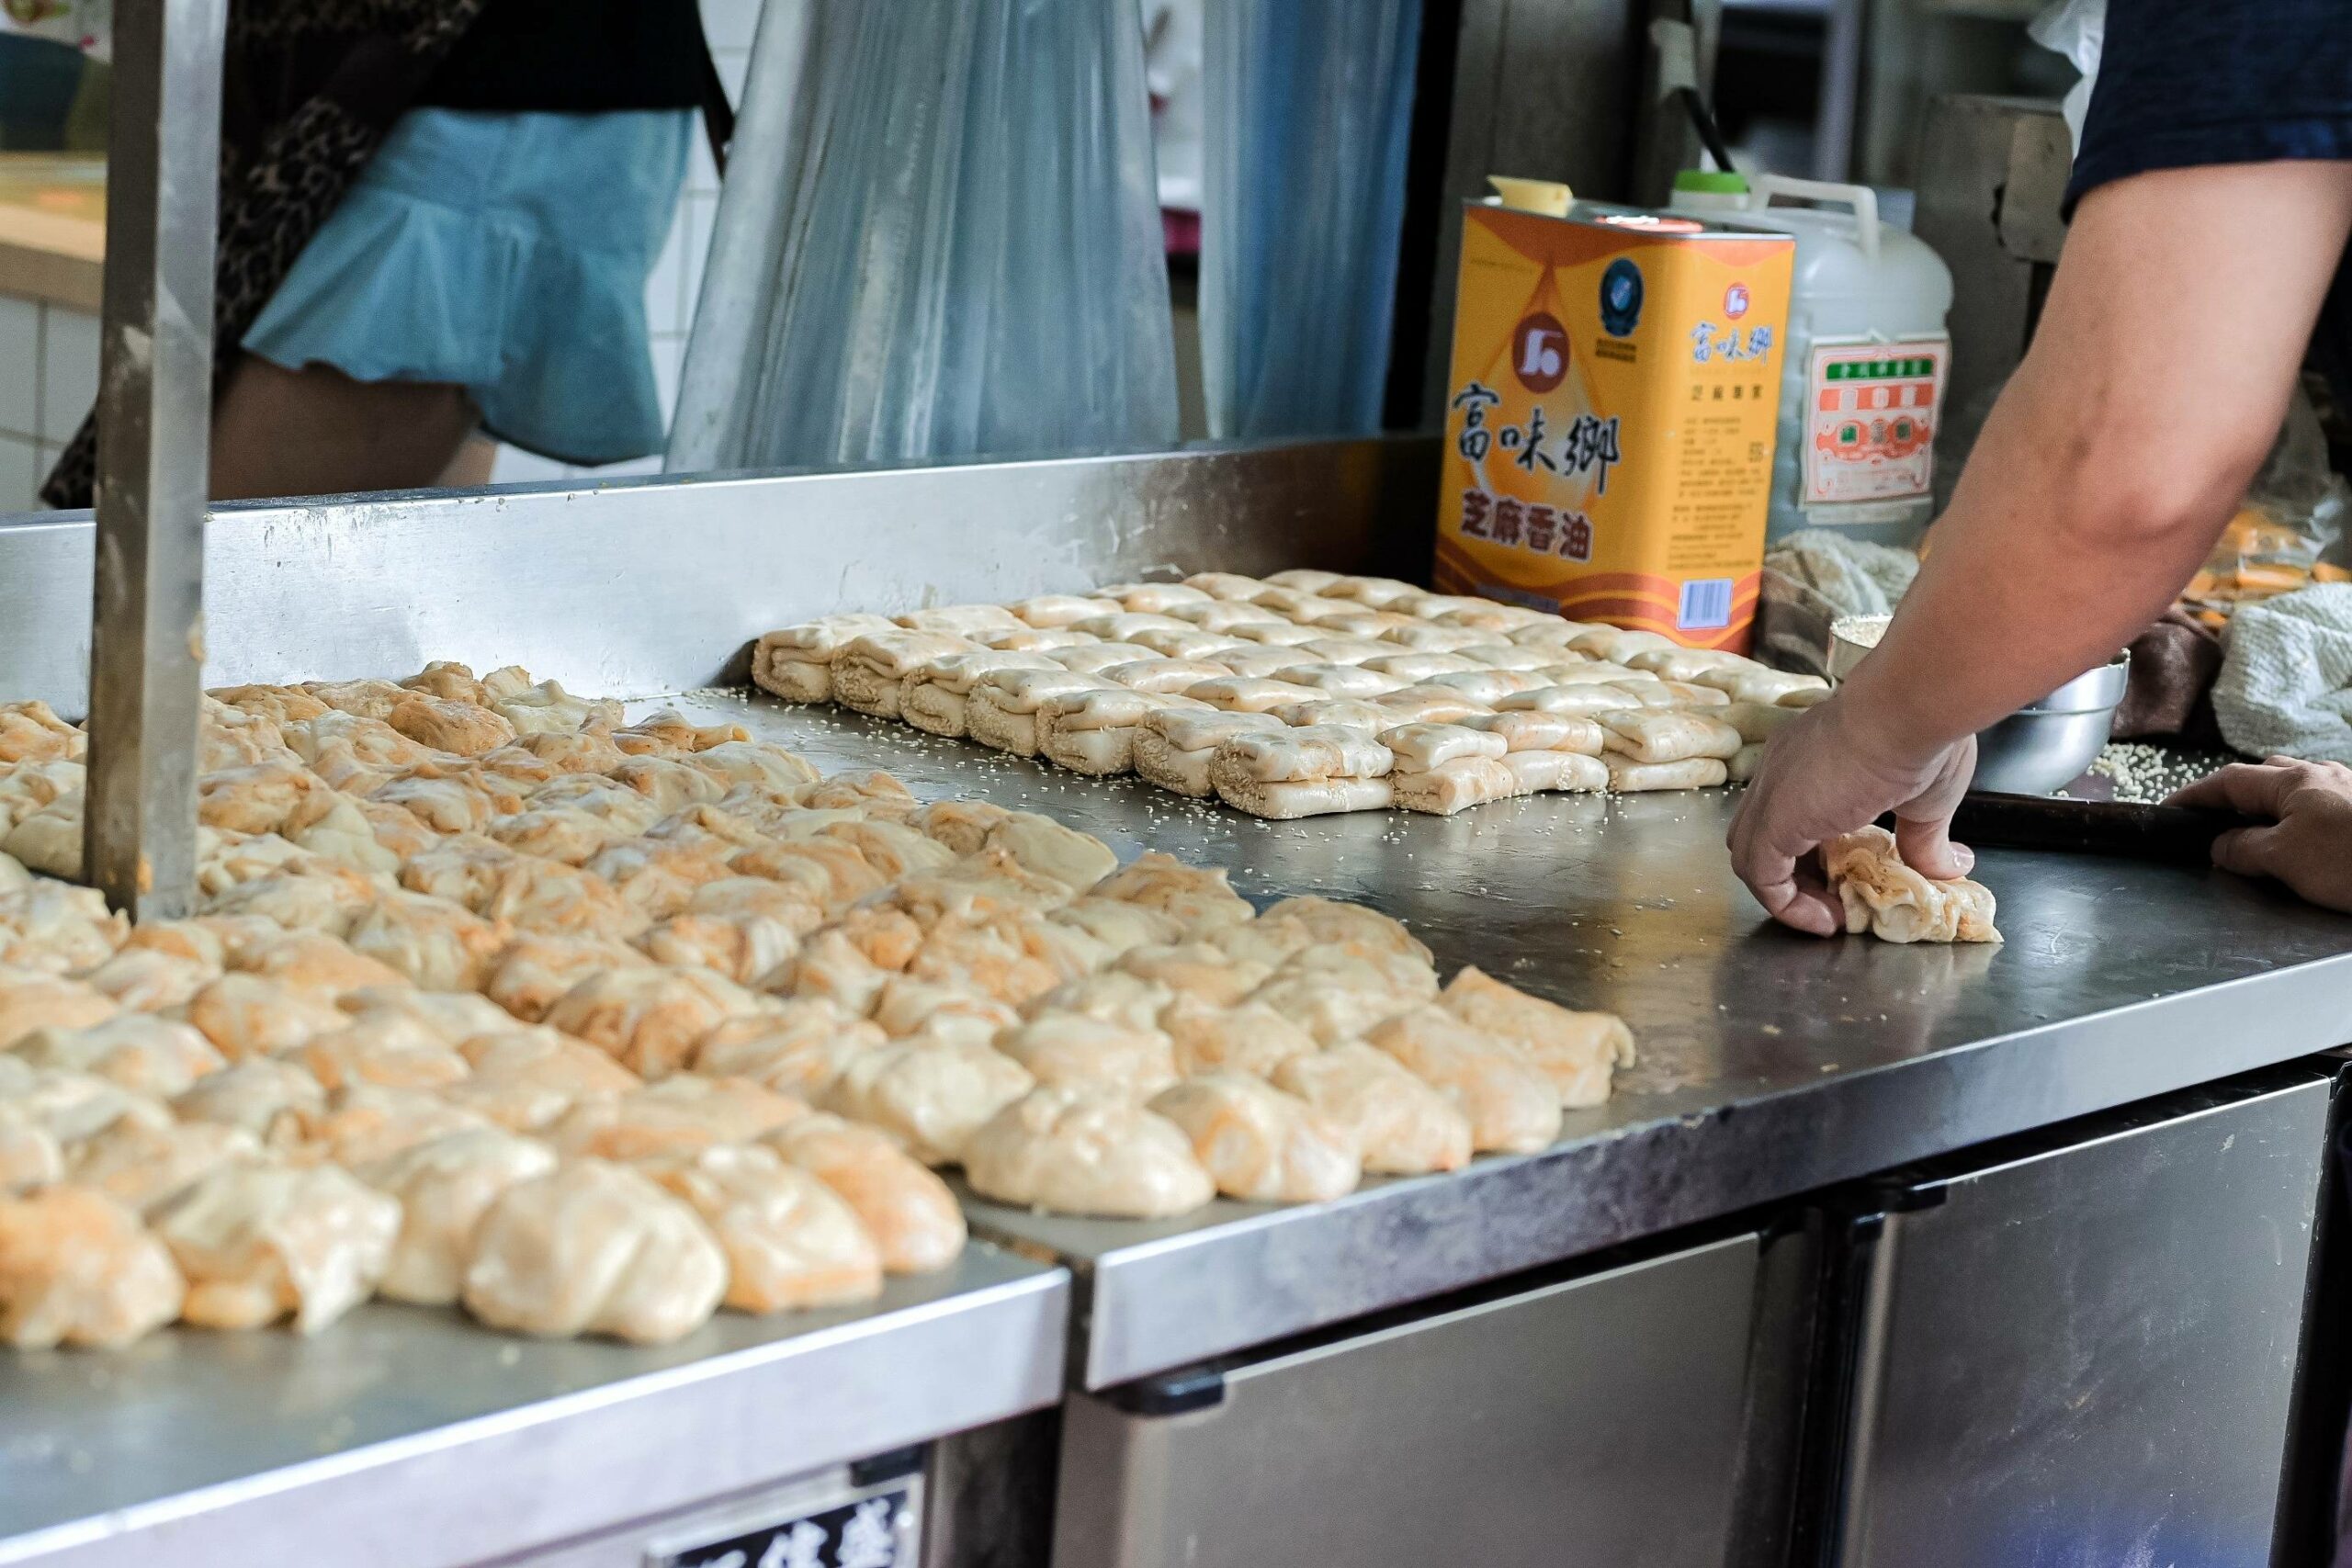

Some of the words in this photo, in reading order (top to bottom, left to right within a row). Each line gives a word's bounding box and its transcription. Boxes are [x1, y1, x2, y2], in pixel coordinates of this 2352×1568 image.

[1690, 321, 1772, 366] 富味鄉
[1452, 381, 1620, 496] 富味鄉
[1460, 490, 1592, 562] 芝麻香油
